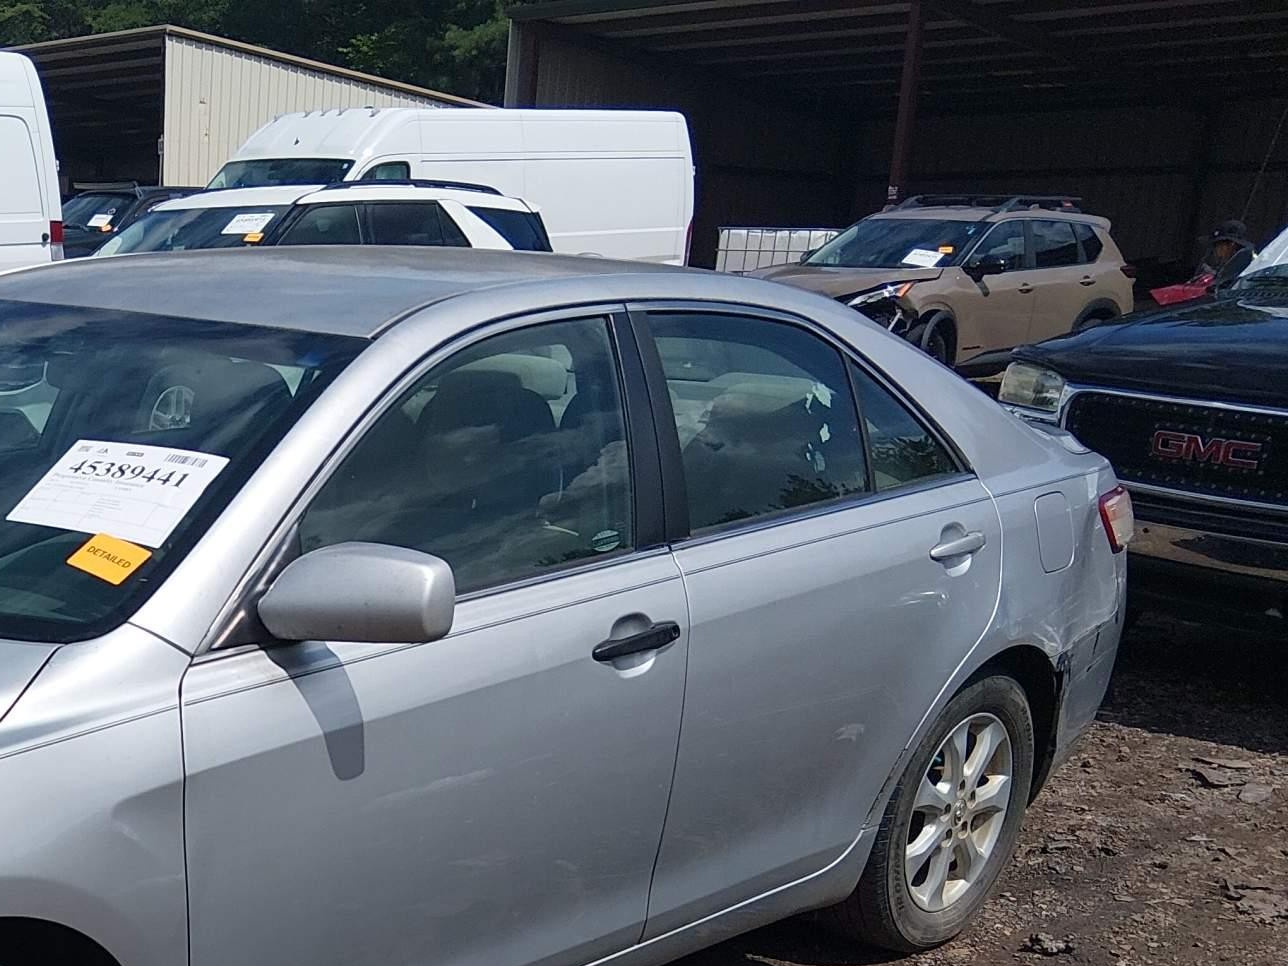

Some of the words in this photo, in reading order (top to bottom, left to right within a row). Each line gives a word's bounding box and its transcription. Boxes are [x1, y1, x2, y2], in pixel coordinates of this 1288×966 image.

[1152, 429, 1263, 470] GMC
[69, 458, 191, 488] 45389441
[86, 545, 132, 570] DETAILED
